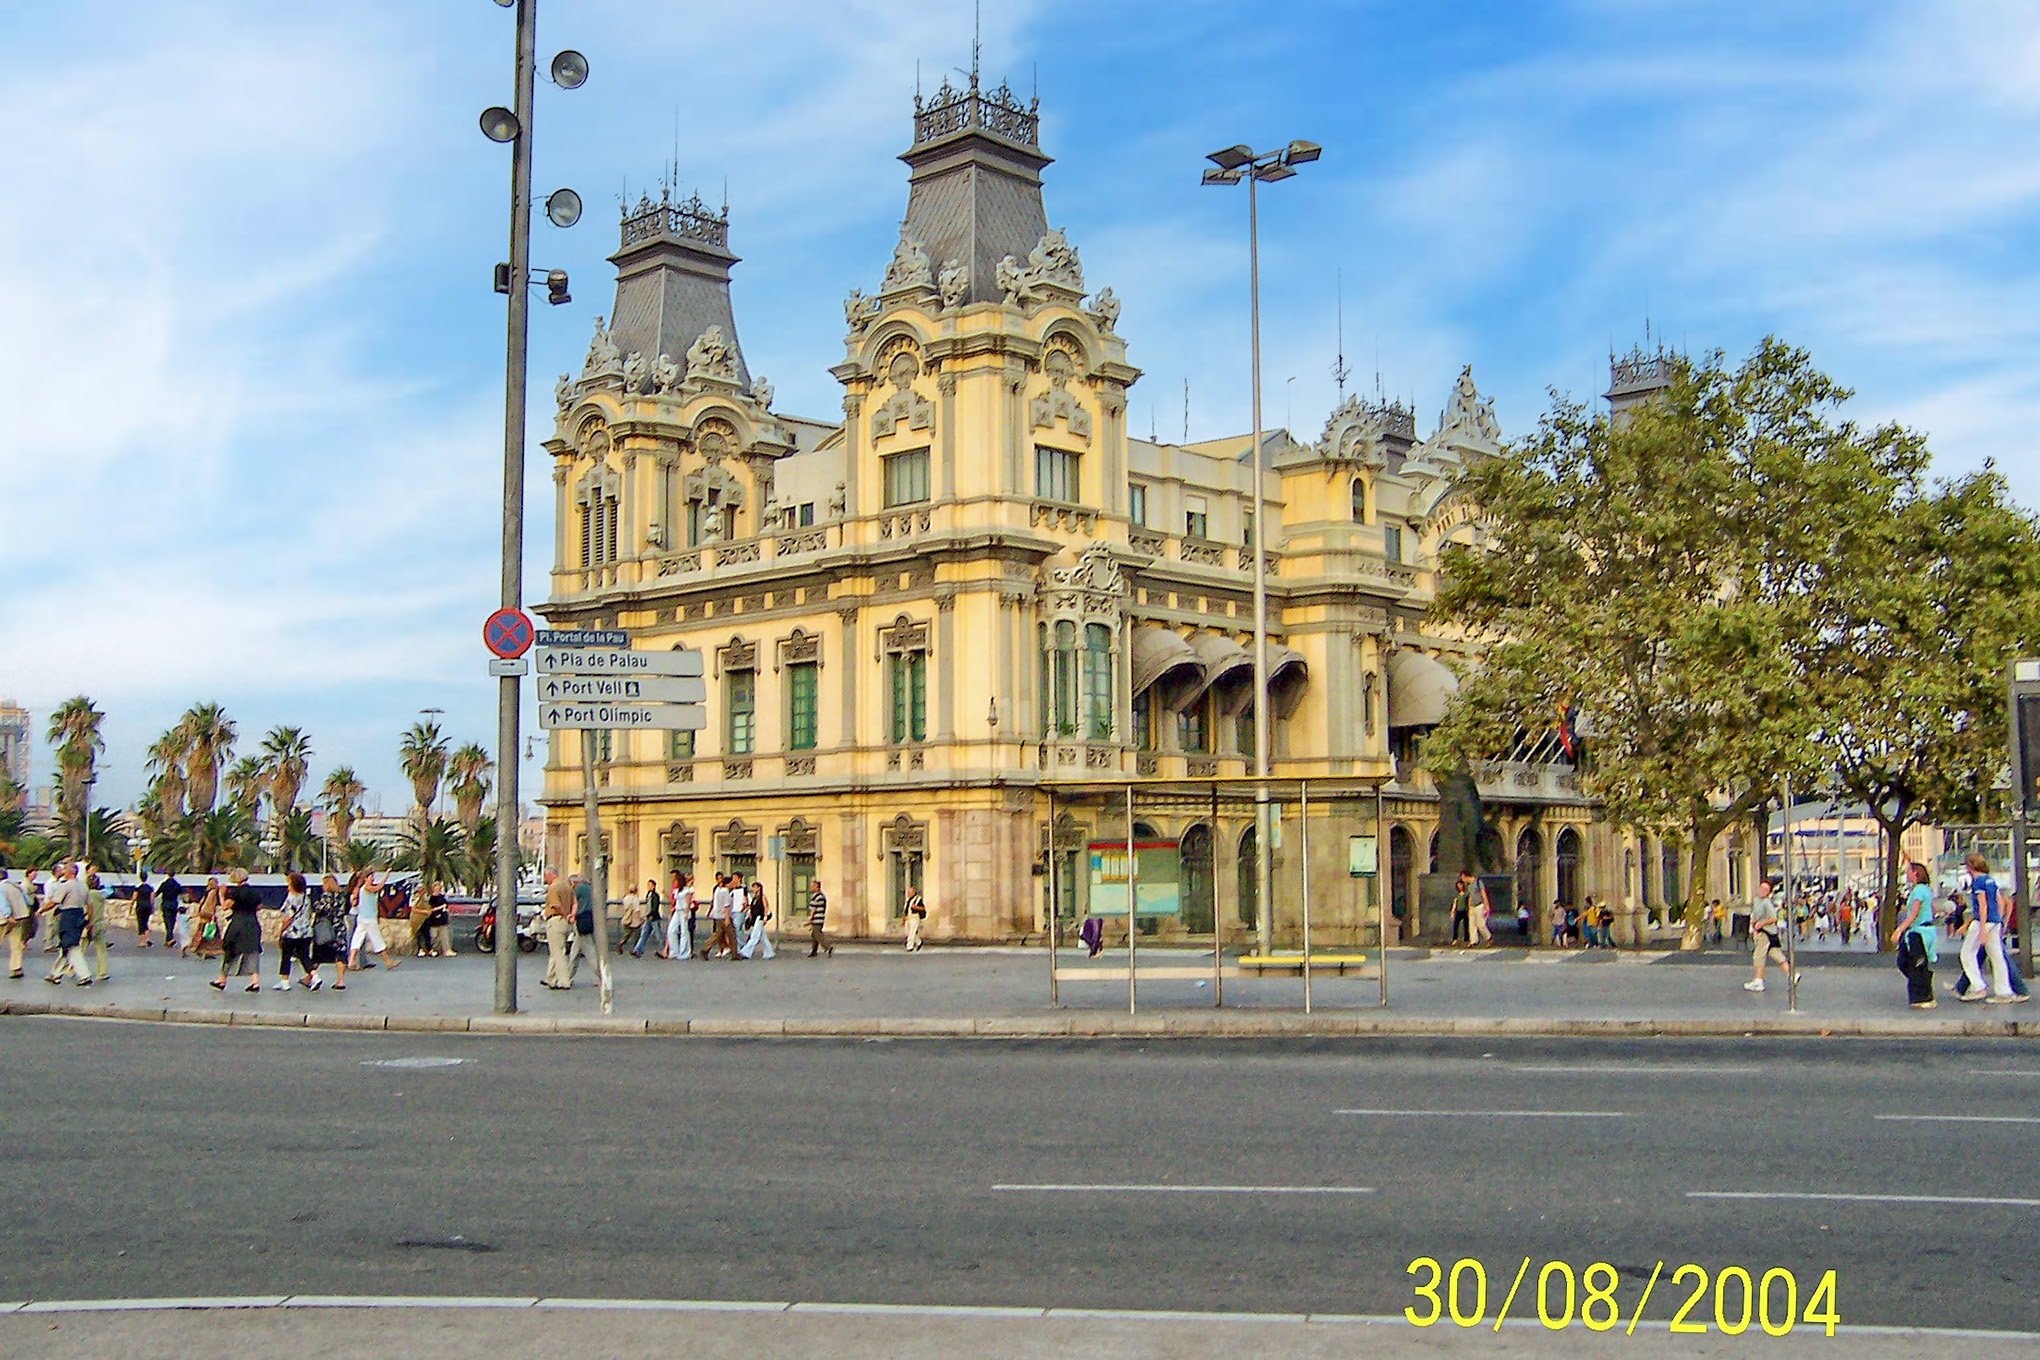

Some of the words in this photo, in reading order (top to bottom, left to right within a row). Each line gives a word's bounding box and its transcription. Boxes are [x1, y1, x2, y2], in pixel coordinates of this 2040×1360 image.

[560, 652, 582, 666] Pla
[588, 653, 604, 667] de
[610, 653, 647, 667] Palau
[563, 680, 592, 694] Port
[596, 681, 621, 694] Vell
[565, 708, 594, 721] Port
[599, 708, 652, 724] Olímpic
